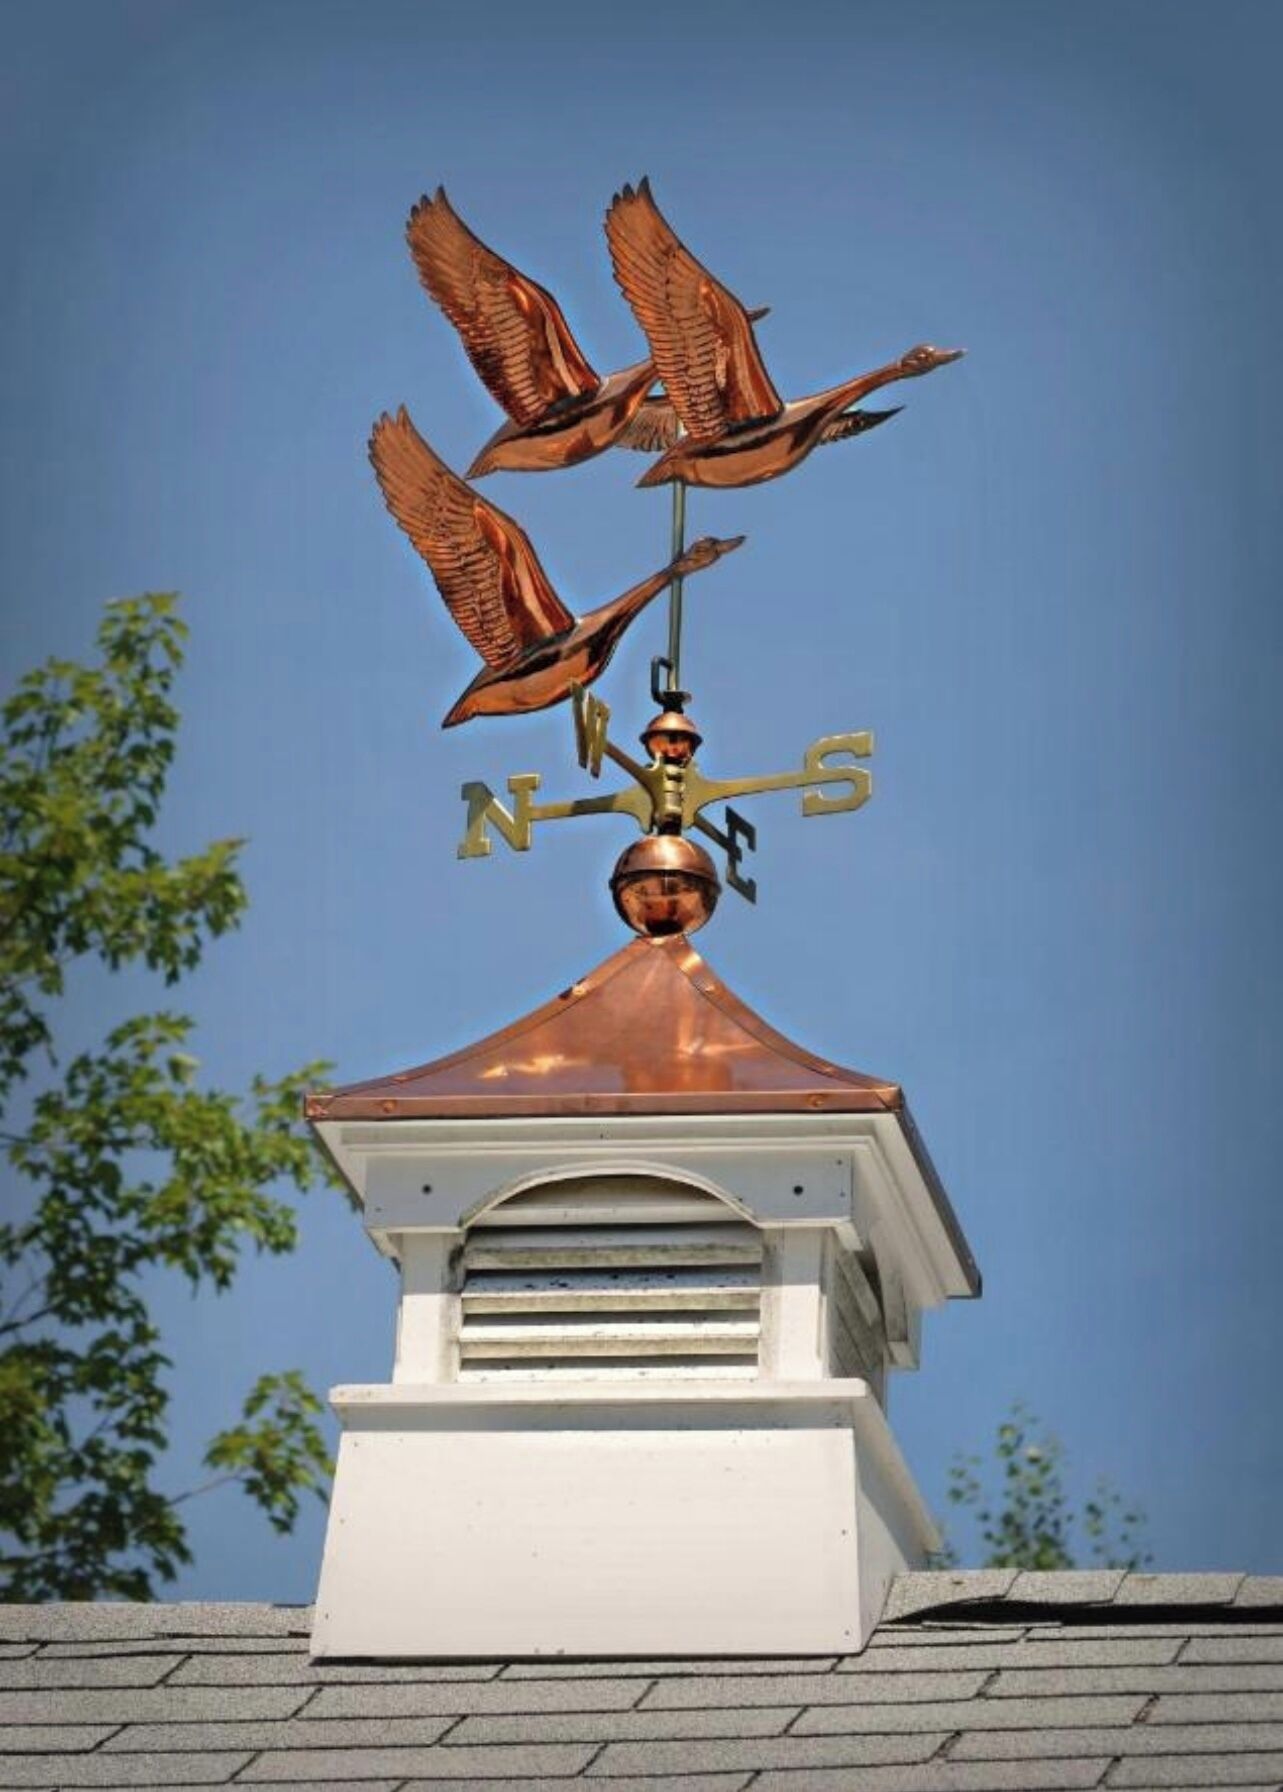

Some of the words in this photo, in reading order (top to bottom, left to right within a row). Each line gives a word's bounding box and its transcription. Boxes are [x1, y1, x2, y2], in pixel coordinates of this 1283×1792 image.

[457, 773, 541, 859] N
[802, 730, 874, 817] S
[725, 805, 757, 904] E
